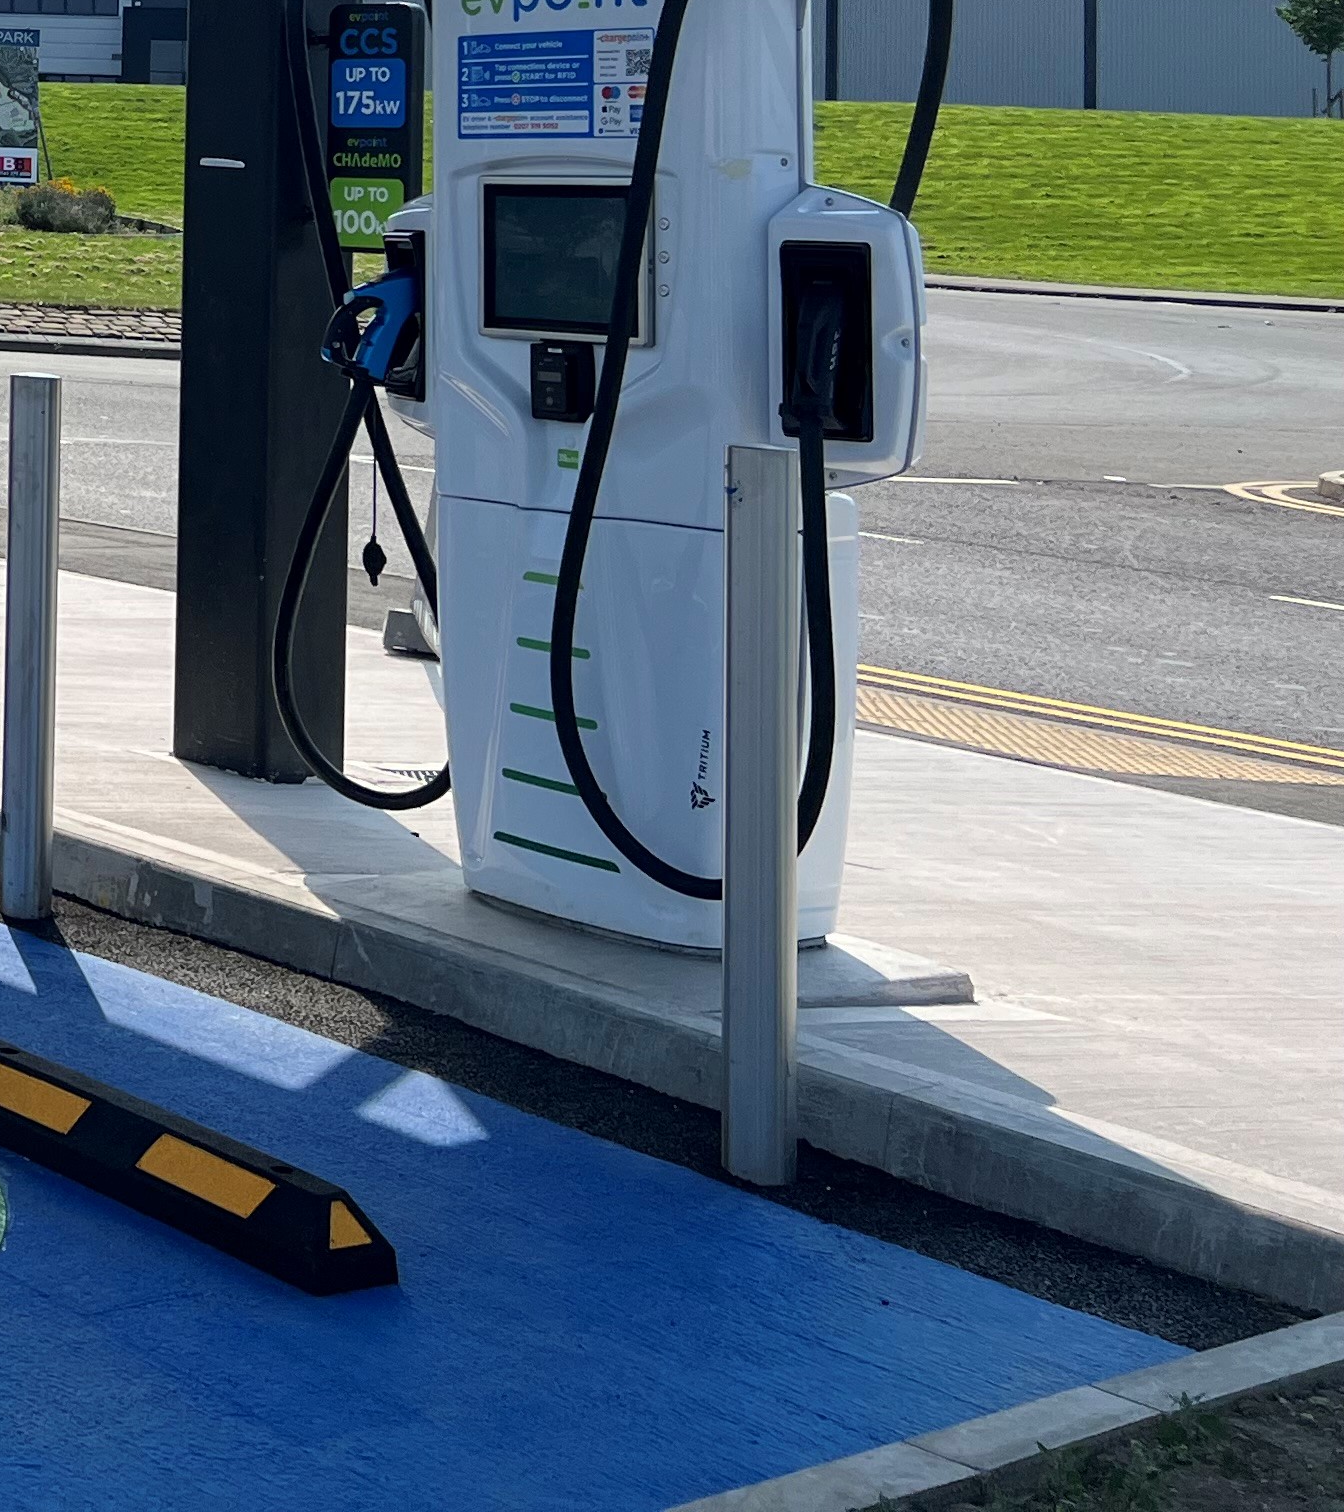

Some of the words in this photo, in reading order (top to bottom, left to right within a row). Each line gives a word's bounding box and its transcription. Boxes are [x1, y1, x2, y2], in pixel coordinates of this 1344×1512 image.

[340, 27, 399, 56] CCS
[462, 41, 469, 56] 1
[345, 67, 366, 83] UP
[368, 66, 391, 83] TO
[462, 70, 469, 82] 2
[462, 94, 469, 107] 3
[332, 152, 402, 169] CHAdeMO
[343, 186, 365, 202] UP
[366, 186, 390, 203] TO
[333, 209, 387, 236] 100k
[697, 729, 711, 780] TRITIUM
